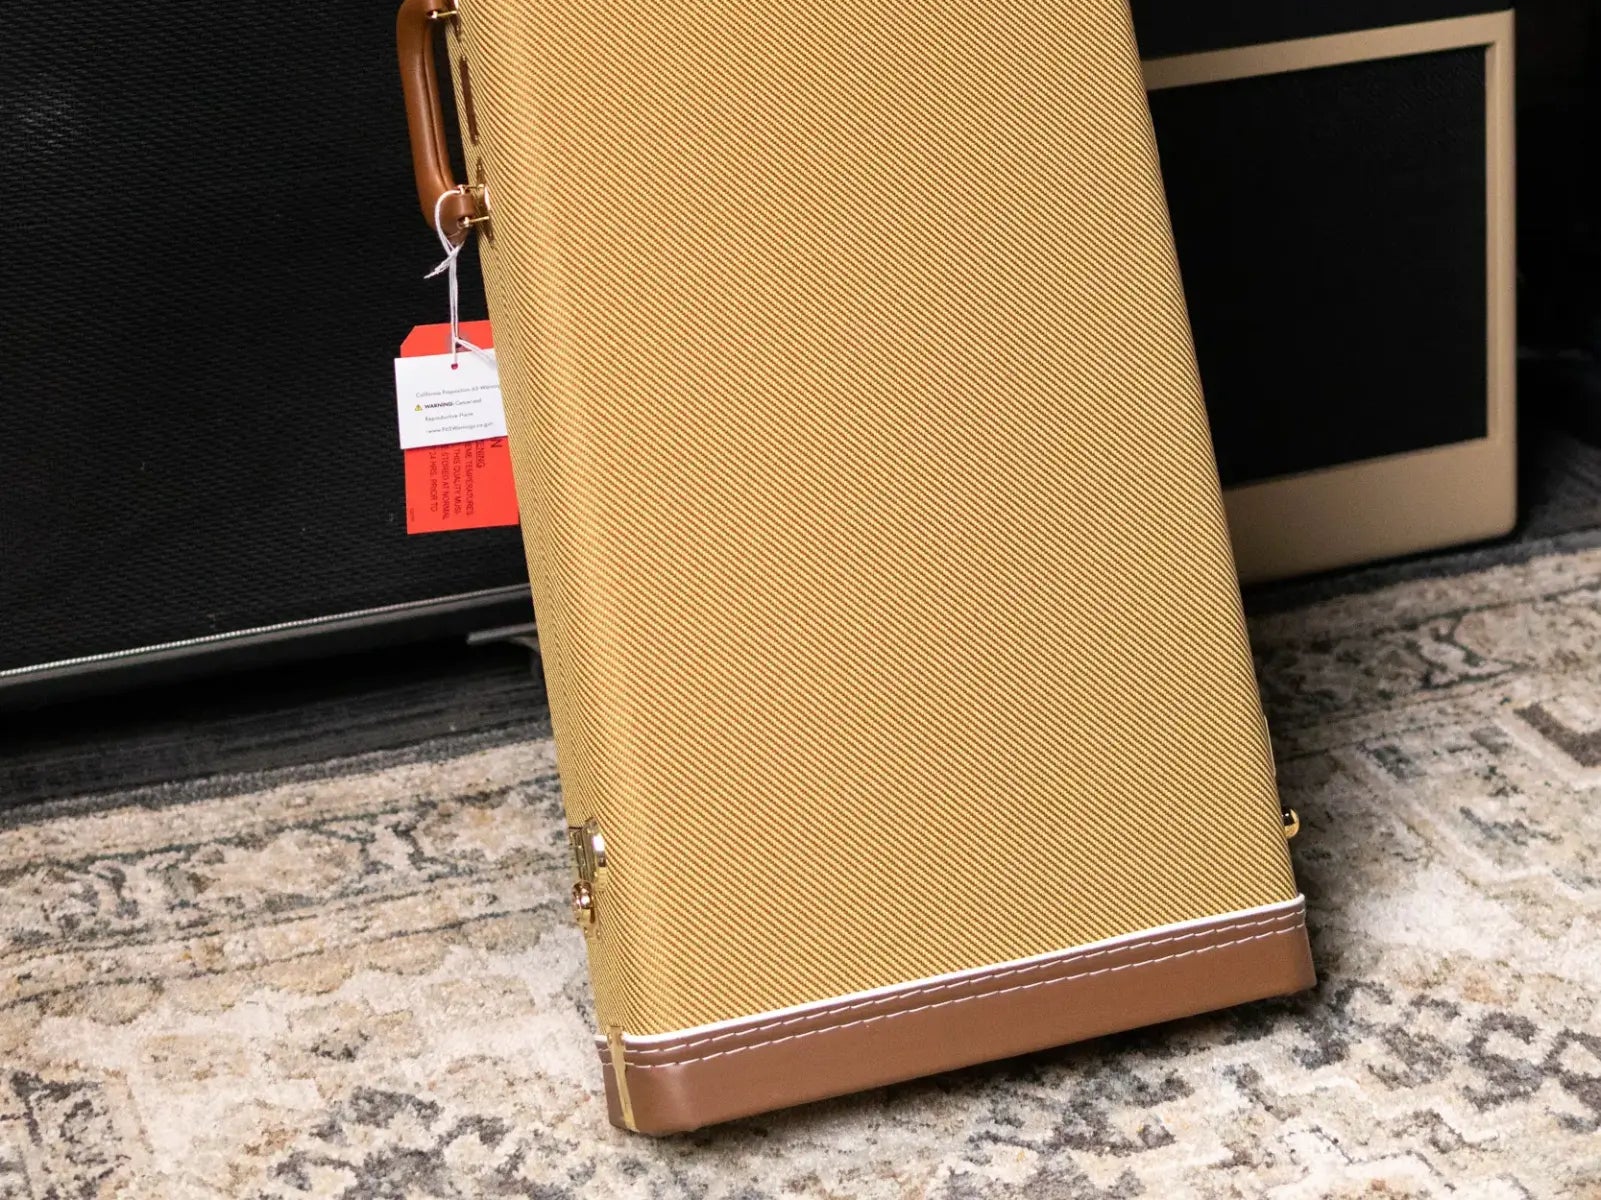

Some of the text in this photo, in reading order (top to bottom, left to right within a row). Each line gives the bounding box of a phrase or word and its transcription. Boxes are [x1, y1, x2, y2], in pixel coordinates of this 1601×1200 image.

[453, 449, 461, 465] THIS
[441, 452, 450, 520] STORED AT NORMAL
[452, 466, 461, 494] QUALITY
[465, 461, 474, 515] TEMPERATURES
[430, 503, 438, 512] TO
